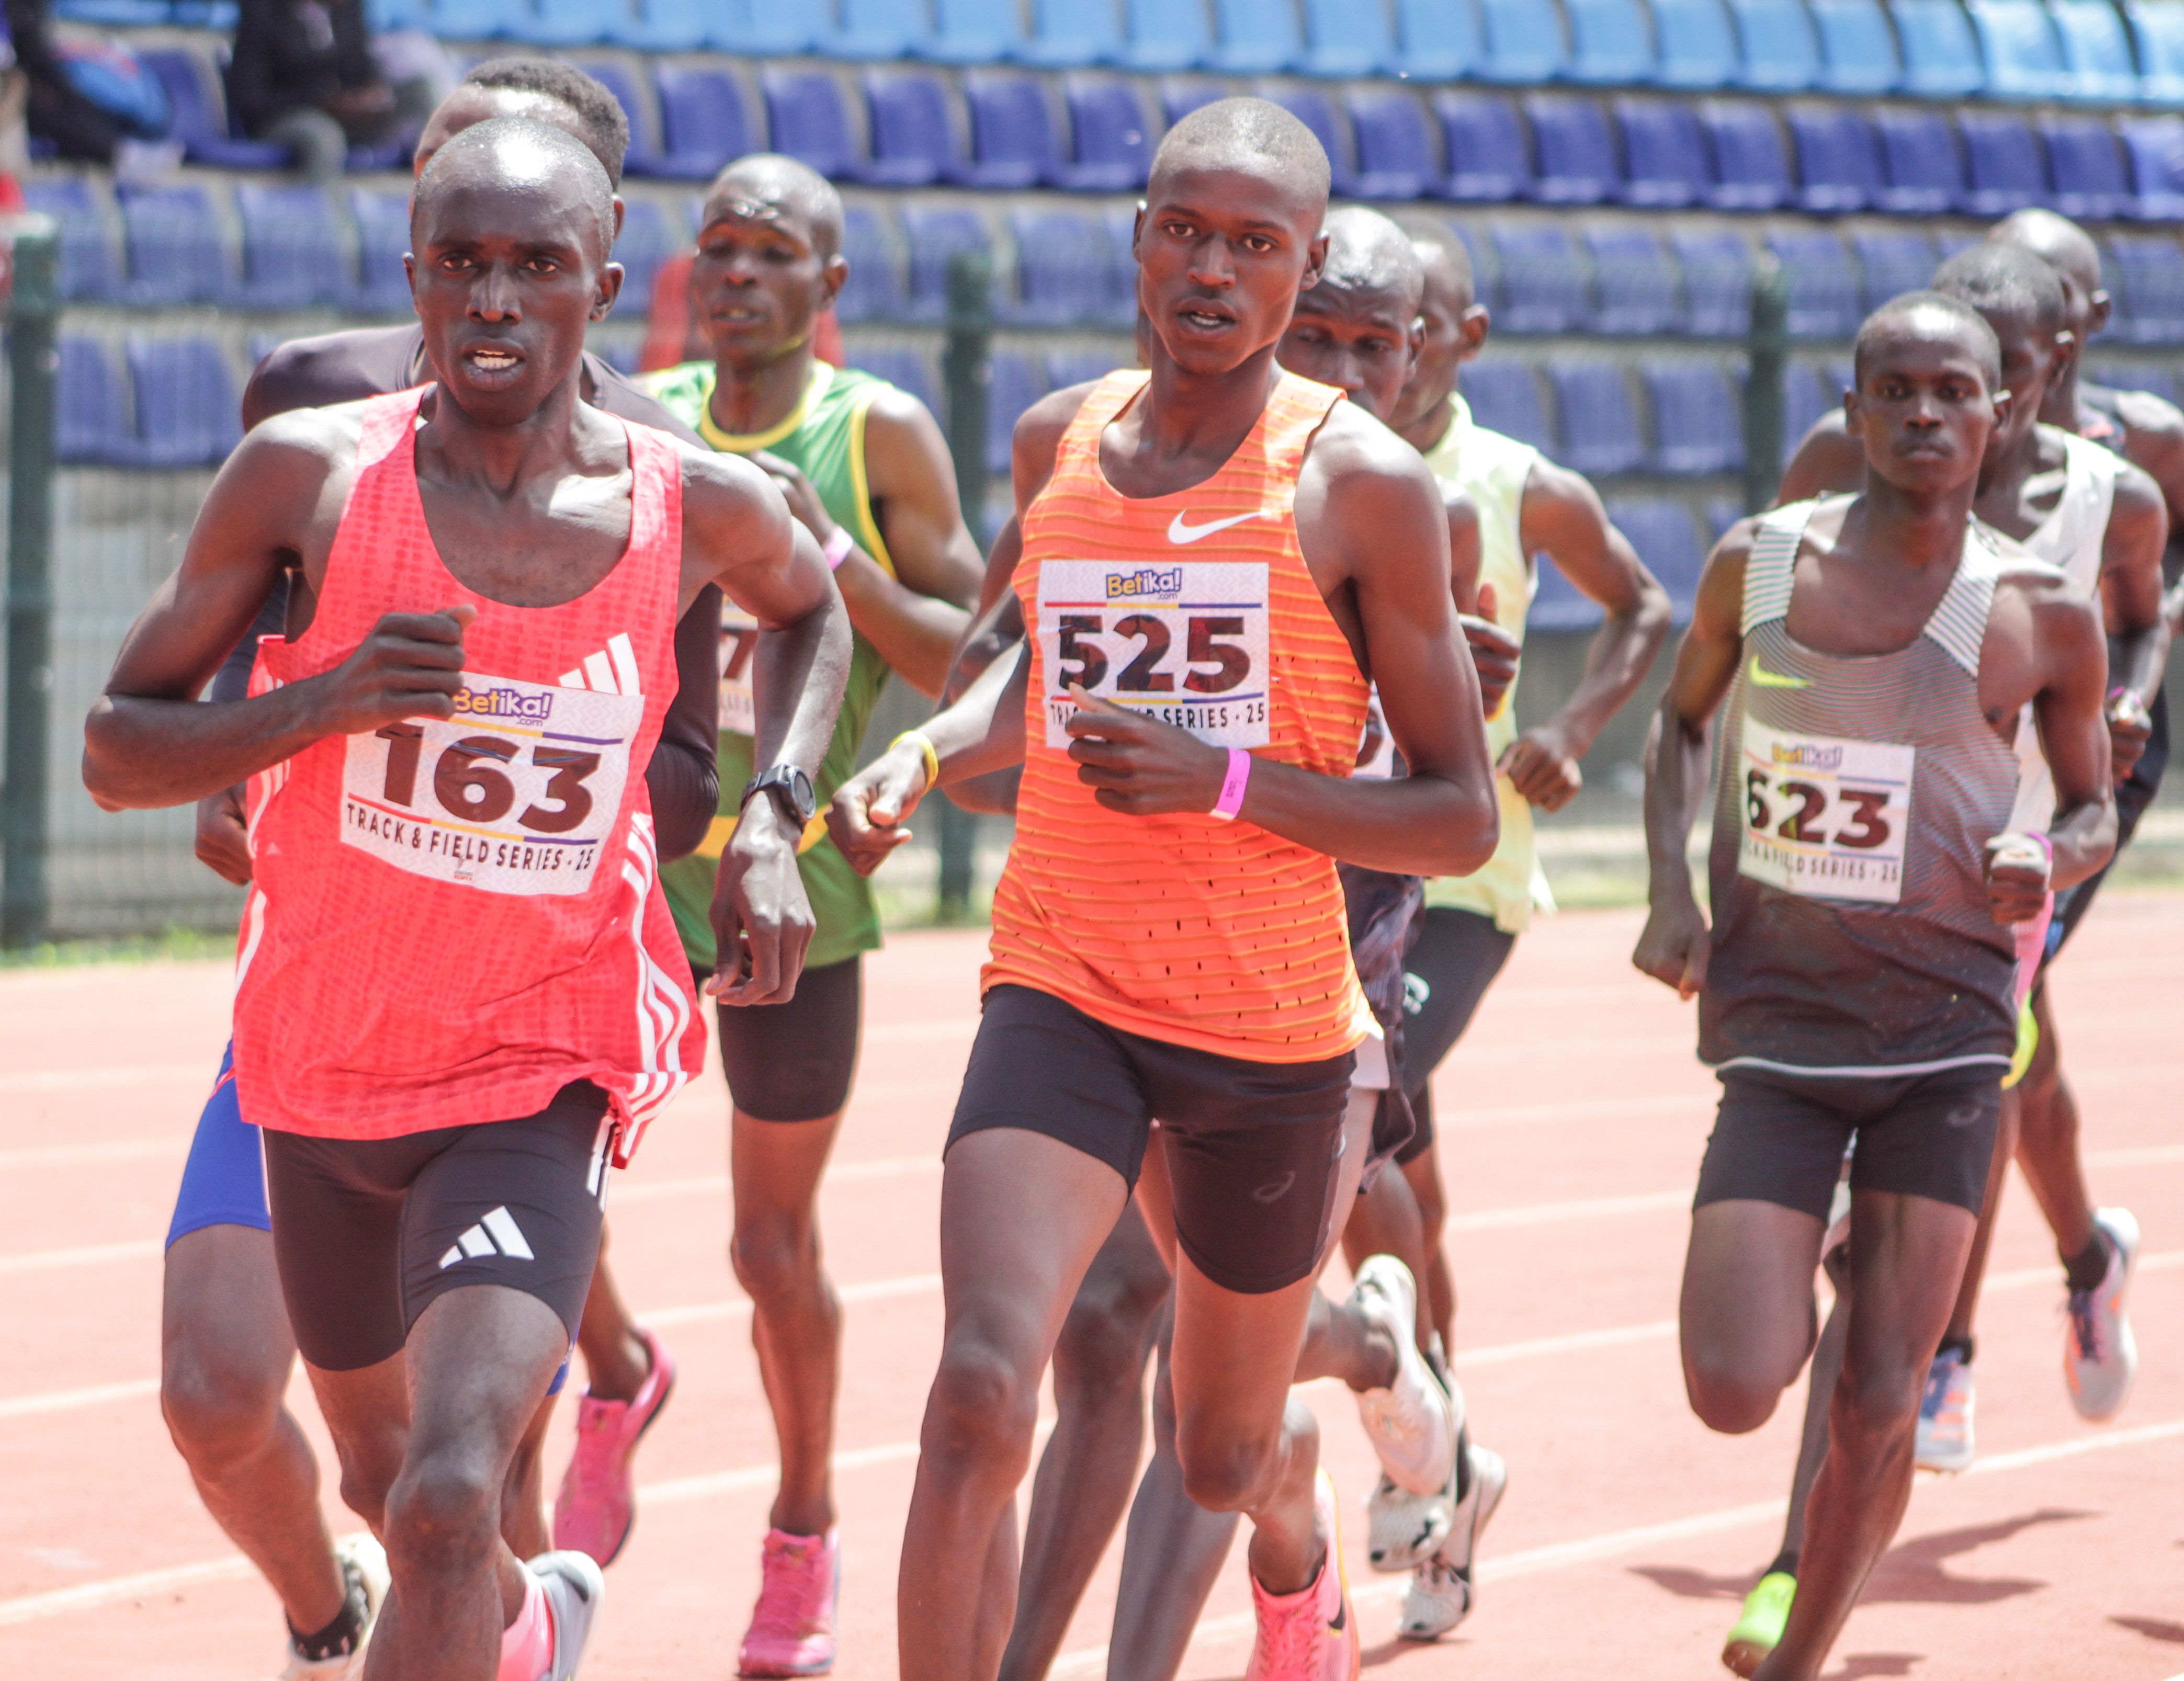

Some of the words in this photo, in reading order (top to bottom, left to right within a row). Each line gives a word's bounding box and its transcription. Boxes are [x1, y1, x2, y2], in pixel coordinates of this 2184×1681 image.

[1106, 569, 1182, 598] Betika!
[1058, 614, 1251, 693] 525
[517, 717, 543, 727] .com
[1164, 707, 1227, 728] SERIES
[1247, 703, 1265, 723] 25
[375, 722, 602, 833] 163
[1748, 769, 1891, 848] 623
[347, 803, 405, 845] TRACK
[411, 827, 422, 849] &
[429, 831, 489, 863] FIELD
[496, 844, 563, 870] SERIES
[576, 848, 593, 871] 25
[1810, 857, 1866, 880] SERIES
